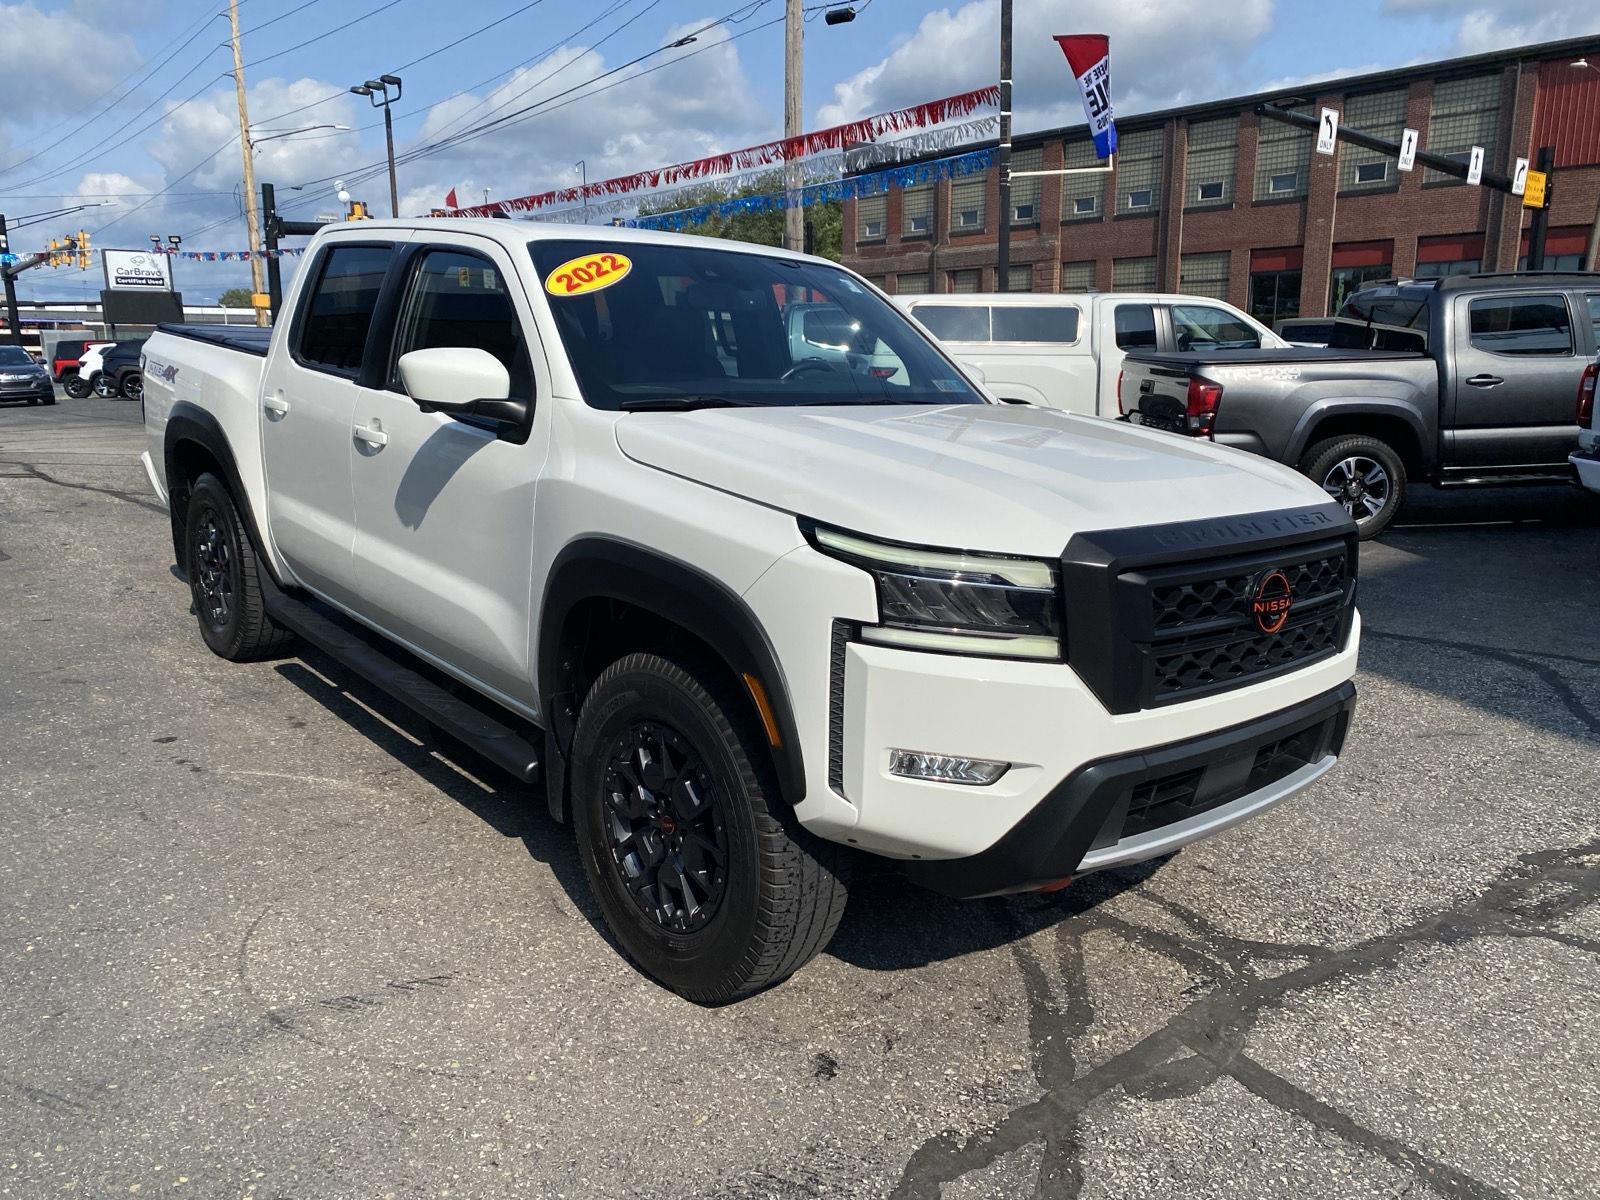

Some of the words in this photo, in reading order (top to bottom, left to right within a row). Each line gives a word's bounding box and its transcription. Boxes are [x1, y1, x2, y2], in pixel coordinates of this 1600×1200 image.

[1319, 139, 1333, 150] ONLY
[116, 267, 162, 277] CarBravo
[555, 255, 625, 293] 2022
[1153, 511, 1333, 548] FRONTIER
